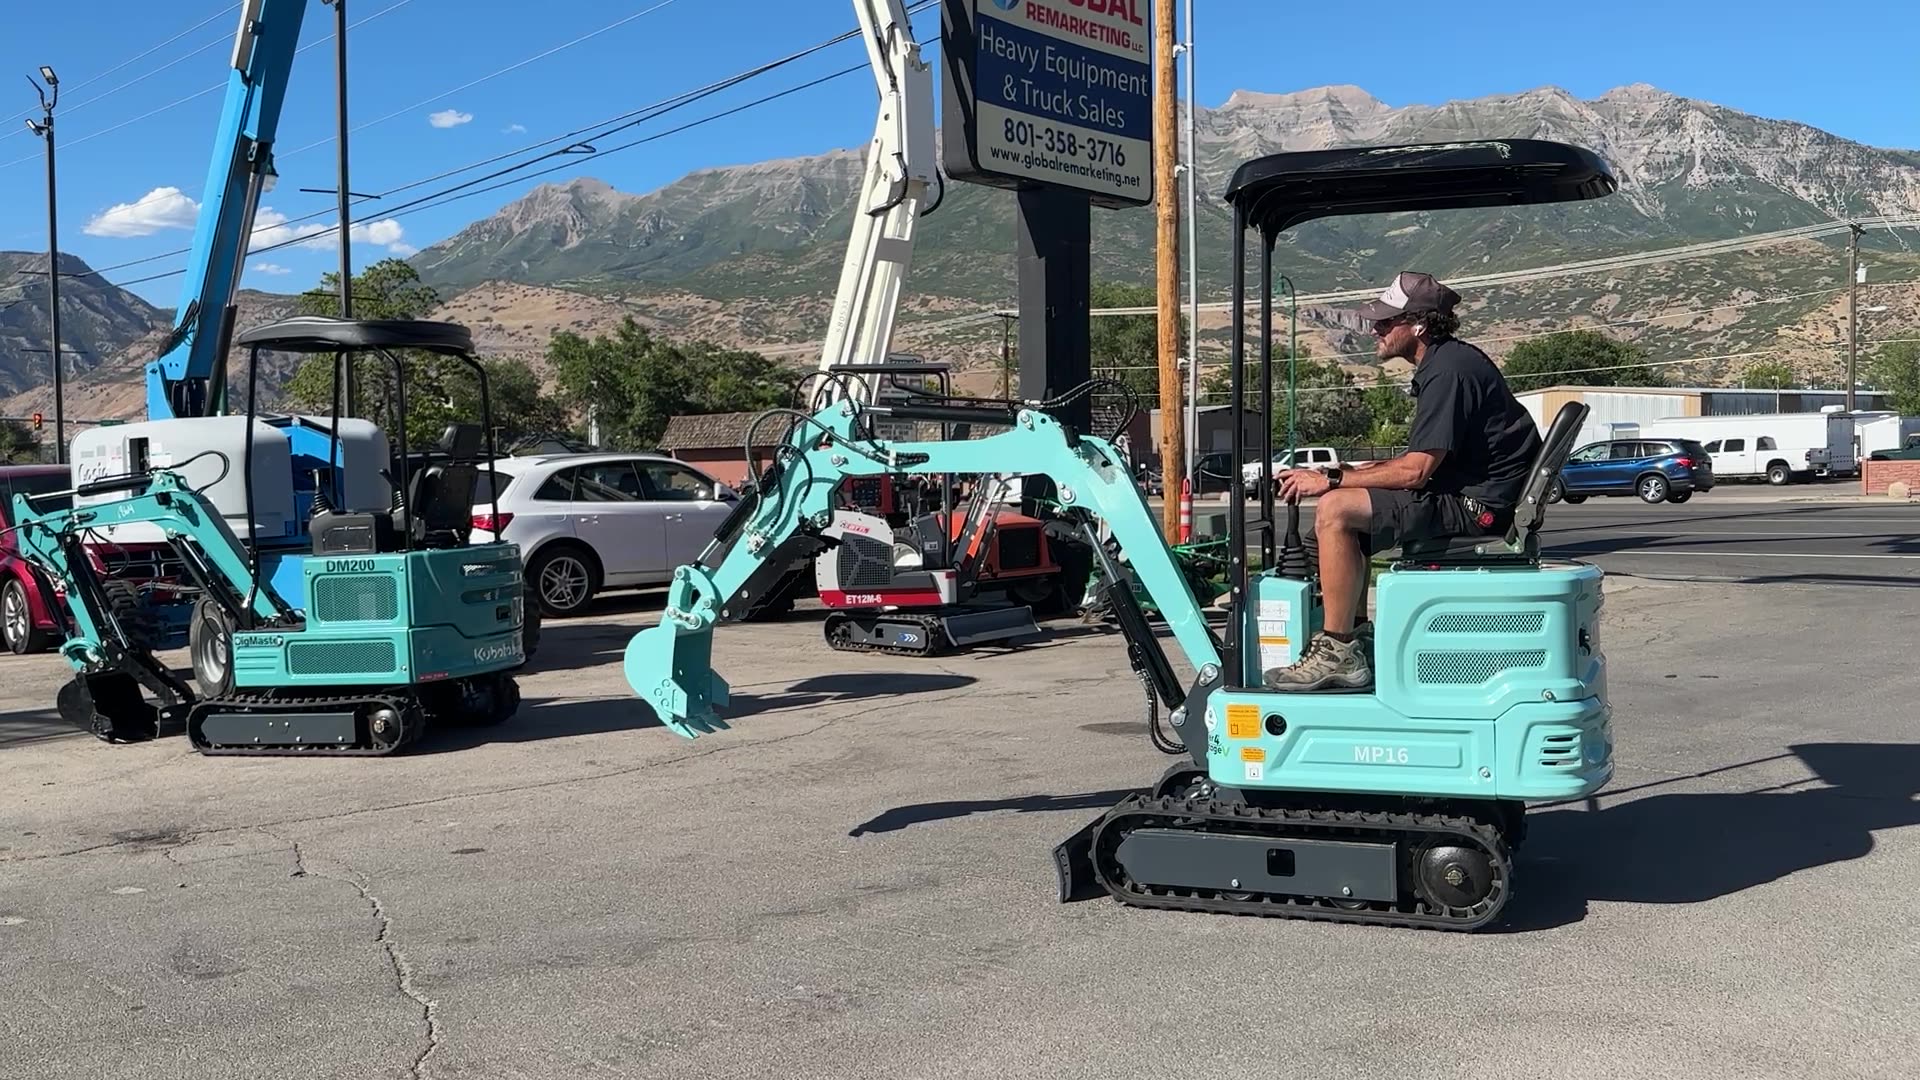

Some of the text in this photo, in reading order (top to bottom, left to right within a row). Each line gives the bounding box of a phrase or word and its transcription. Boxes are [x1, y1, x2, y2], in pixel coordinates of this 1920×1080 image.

[1026, 2, 1144, 52] REMARKETING LLC
[980, 24, 1148, 96] Heavy Equipment
[1003, 74, 1125, 129] & Truck Sales
[1004, 118, 1126, 167] 801-358-3716
[990, 147, 1140, 187] www.globalremarketing.net
[326, 559, 375, 572] DM200
[845, 594, 882, 605] ET12M-6
[235, 636, 284, 647] DigMaste
[1354, 745, 1409, 764] MP16
